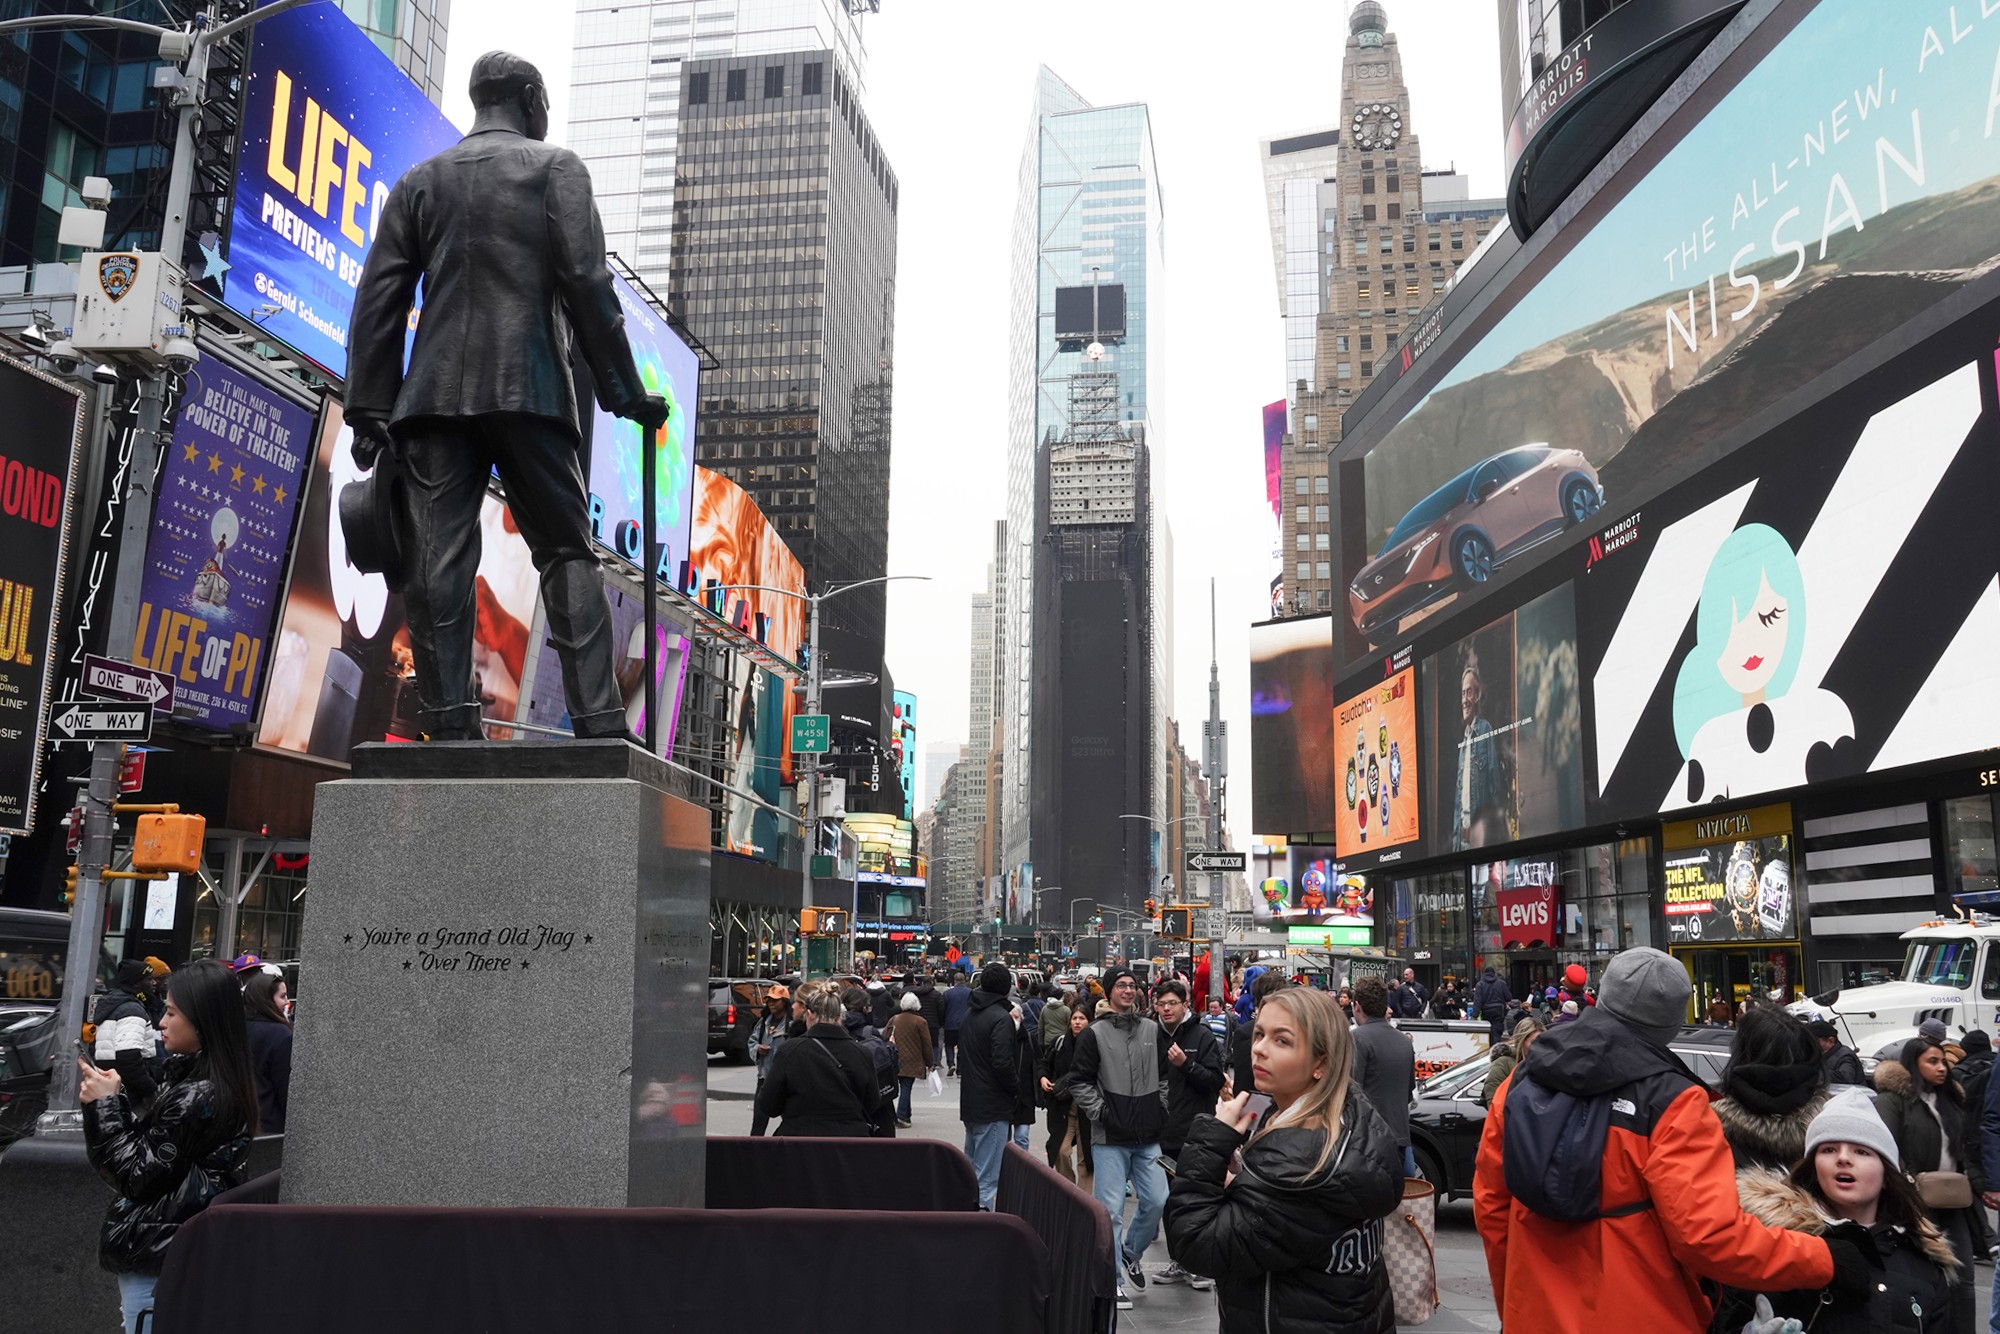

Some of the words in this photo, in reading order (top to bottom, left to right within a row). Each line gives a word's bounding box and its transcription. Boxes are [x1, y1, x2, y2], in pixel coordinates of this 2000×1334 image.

[1524, 34, 1593, 114] MARRIOTT
[1525, 65, 1584, 135] MARQUIS
[267, 70, 372, 249] LIFE
[1663, 216, 1715, 282] THE
[1731, 68, 1896, 231] ALL-NEW,
[261, 192, 336, 272] PREVIEWS
[1665, 107, 1925, 370] NISSAN
[265, 279, 297, 314] Gerald
[298, 300, 345, 346] Schoenfeld
[1413, 306, 1444, 346] MARRIOTT
[164, 326, 185, 336] NYPD
[1414, 325, 1441, 360] MARQUIS
[232, 384, 248, 404] WILL
[248, 394, 268, 415] MAKE
[268, 405, 282, 423] YOU
[185, 402, 228, 438] POWER
[228, 423, 245, 446] OF
[204, 387, 252, 428] BELIEVE
[253, 413, 267, 436] IN
[269, 421, 290, 449] THE
[1604, 512, 1641, 541] MARRIOTT
[1605, 528, 1638, 554] MARQUIS
[0, 579, 33, 666] UL
[131, 601, 208, 684] LIFE
[200, 635, 232, 681] OF
[224, 631, 261, 699] PI
[1393, 644, 1413, 662] MARRIOTT
[1393, 656, 1411, 671] MARQUIS
[97, 670, 124, 689] ONE
[136, 679, 161, 698] WAY
[64, 714, 93, 729] ONE
[107, 714, 138, 729] WAY
[805, 719, 816, 727] TO
[1340, 697, 1367, 725] swatch
[815, 729, 824, 737] St
[871, 755, 879, 792] 1500
[1980, 768, 2000, 787] SE
[1696, 814, 1751, 840] INVICTA
[1195, 858, 1212, 867] ONE
[1220, 858, 1239, 866] WAY
[1665, 869, 1684, 885] THE
[1685, 867, 1704, 883] NFL
[1666, 883, 1724, 903] COLLECTION
[361, 927, 411, 950] You're
[416, 931, 429, 945] a
[433, 927, 492, 950] Grand
[497, 927, 530, 945] Old
[532, 924, 575, 951] Flag
[418, 950, 461, 971] Over
[464, 950, 511, 971] There
